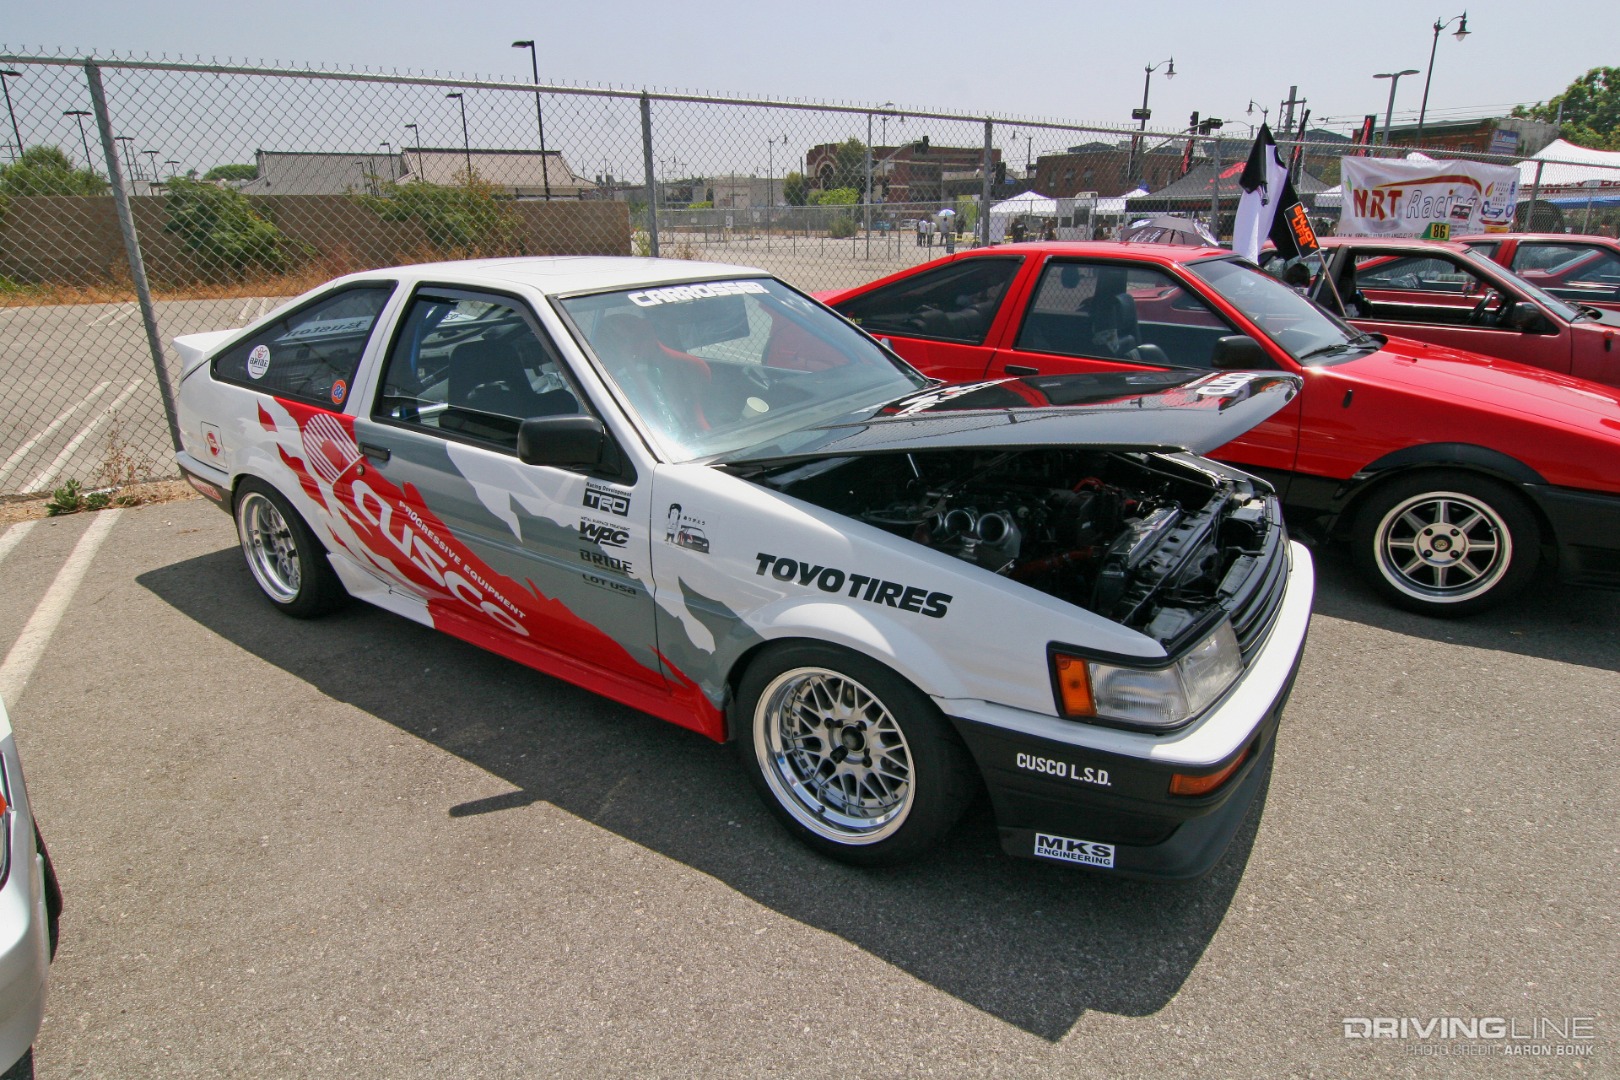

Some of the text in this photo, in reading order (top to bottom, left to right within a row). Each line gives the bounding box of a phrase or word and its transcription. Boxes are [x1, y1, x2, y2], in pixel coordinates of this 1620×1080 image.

[1353, 189, 1402, 221] NRT
[1291, 217, 1308, 246] LIFE
[1294, 205, 1318, 249] ENJOY
[1433, 224, 1446, 239] 86
[627, 282, 770, 307] CARROSSER
[250, 357, 268, 367] BRIDE
[332, 382, 346, 400] 86
[584, 489, 629, 515] TRD
[586, 482, 632, 497] Racing Development
[351, 479, 530, 636] CUSCO
[398, 500, 526, 619] PROGRESSIVE EQUIPMENT
[579, 549, 633, 574] BRIDE
[582, 573, 607, 586] LOT
[756, 552, 953, 619] TOYO TIRES
[1016, 752, 1112, 786] CUSCO L.S.D.
[1037, 835, 1112, 858] MKS
[1037, 847, 1111, 866] ENGINEERING
